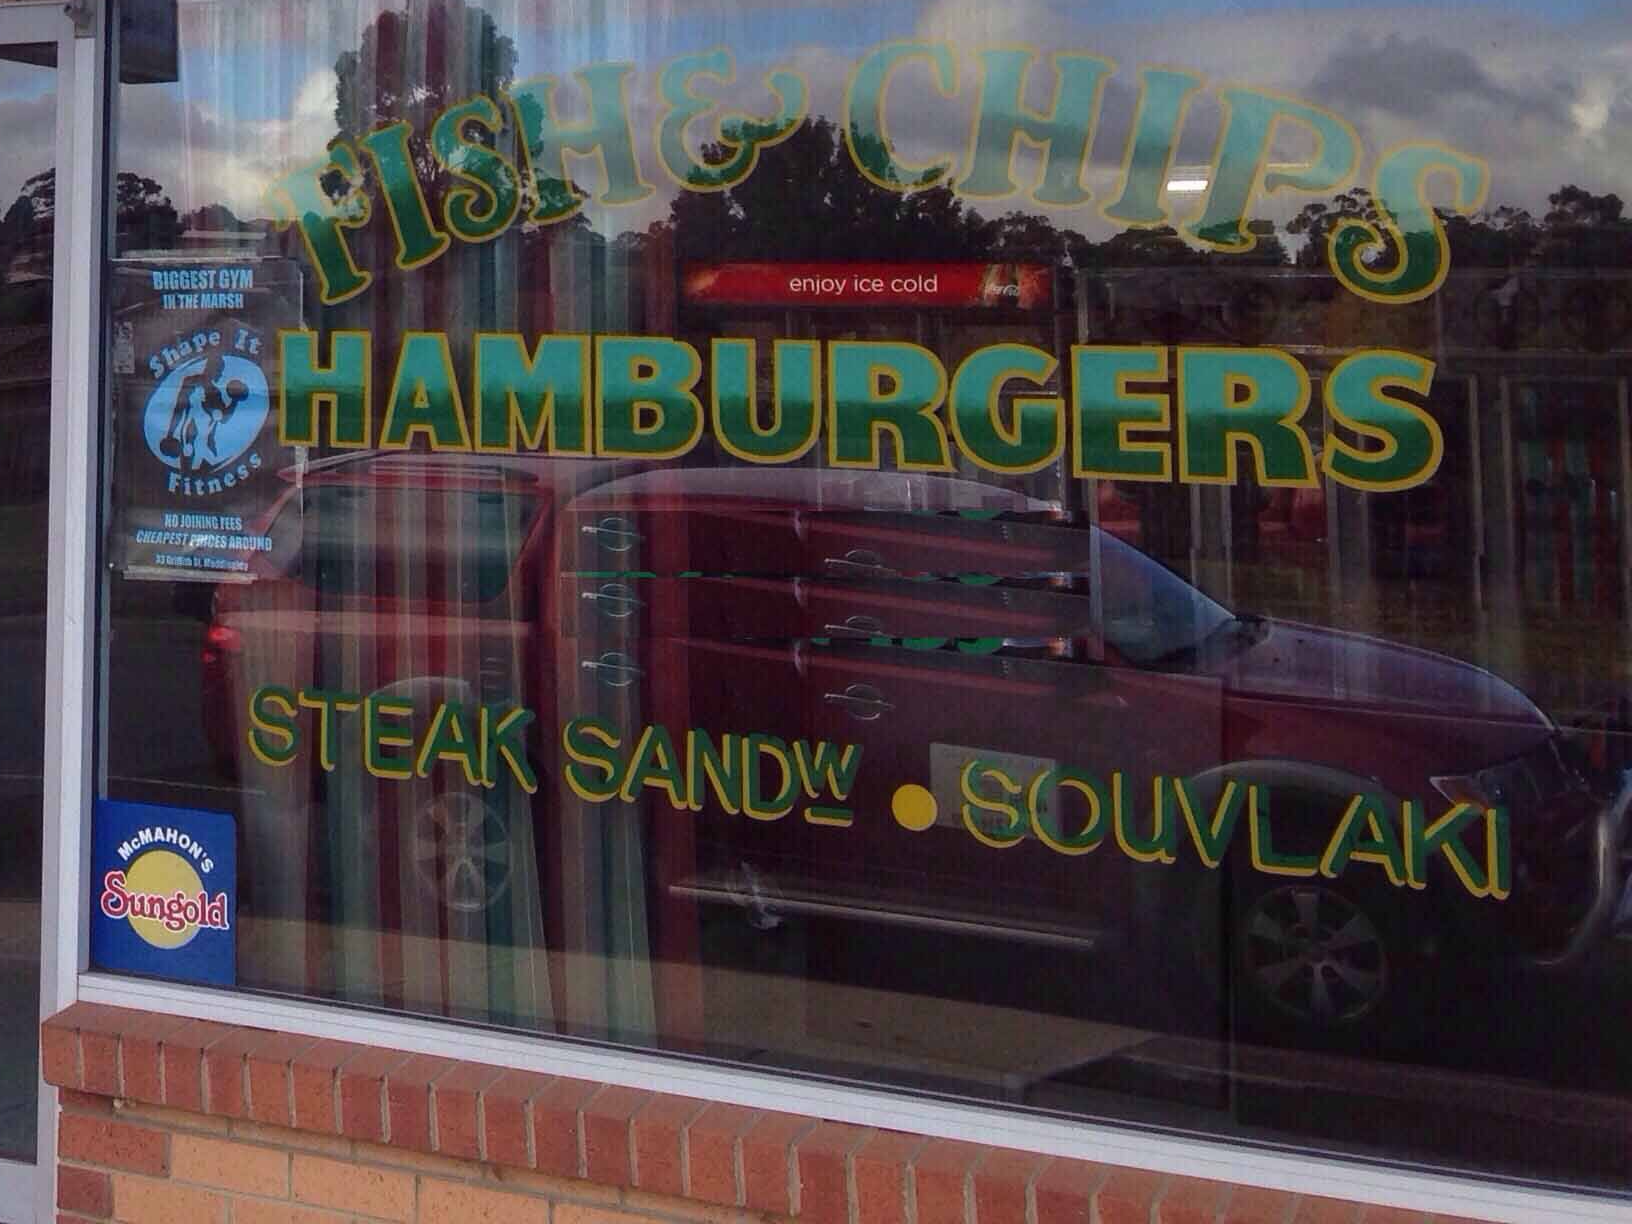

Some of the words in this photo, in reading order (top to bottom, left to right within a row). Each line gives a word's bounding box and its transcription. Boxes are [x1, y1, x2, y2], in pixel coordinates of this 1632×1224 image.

[271, 62, 657, 306] FISH
[655, 46, 810, 194] &
[843, 40, 1489, 303] CHIPS
[152, 270, 216, 290] BIGGEST
[219, 269, 254, 289] GYM
[163, 293, 176, 309] IN
[178, 293, 199, 309] THE
[200, 293, 244, 309] MARSH
[790, 276, 846, 295] enjoy
[854, 275, 884, 292] ice
[891, 275, 938, 293] cold
[149, 330, 221, 378] Shape
[235, 328, 262, 355] It
[278, 328, 1445, 492] HAMBURGERS
[169, 452, 262, 496] Fitness
[136, 530, 188, 545] CHEAPEST
[190, 534, 226, 548] PRICES
[228, 536, 273, 551] AROUND
[165, 514, 179, 527] NO
[180, 514, 220, 529] JOINING
[220, 517, 242, 530] FEES
[249, 683, 538, 794] STEAK
[960, 758, 1511, 900] SOUVLAKI
[117, 827, 214, 873] McMAHON'S
[101, 870, 230, 932] Sungold
